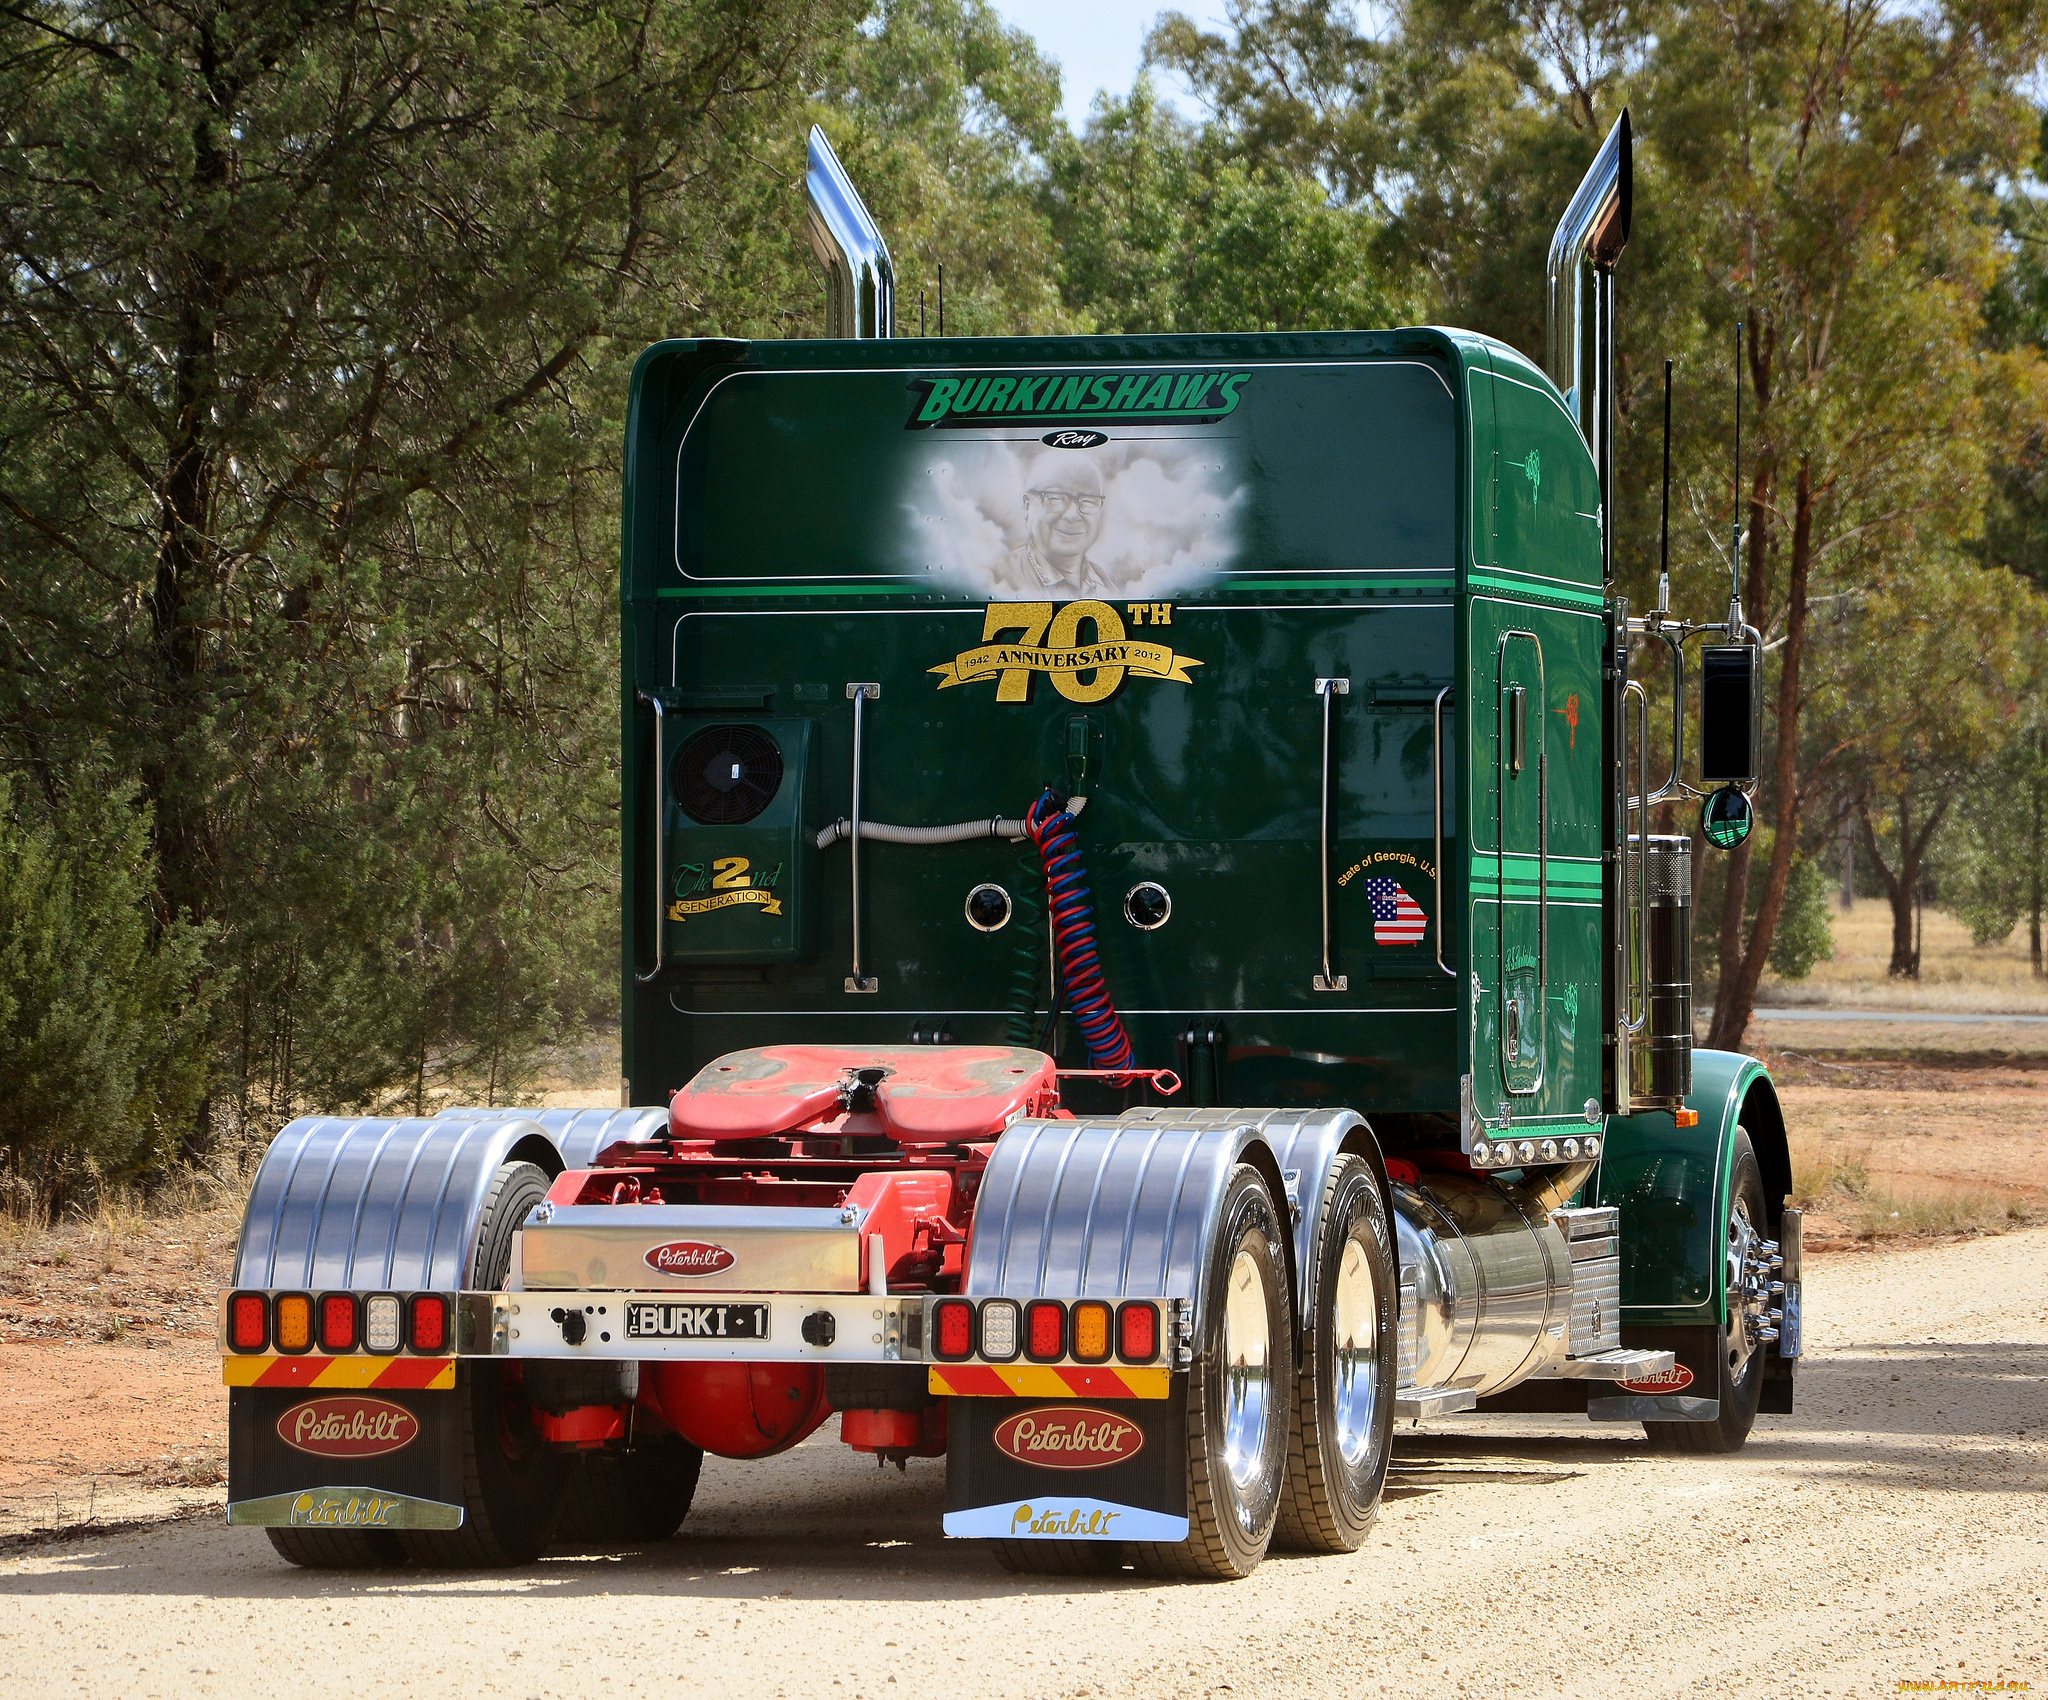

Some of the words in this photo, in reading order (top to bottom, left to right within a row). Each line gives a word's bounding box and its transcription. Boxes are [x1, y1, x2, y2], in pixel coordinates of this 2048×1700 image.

[916, 372, 1252, 422] BURKINSHAW'S
[1053, 431, 1098, 447] Ray
[965, 654, 989, 668] 1942
[996, 646, 1131, 668] ANNIVERSARY
[1134, 648, 1161, 662] 2012
[672, 863, 711, 897] The
[1337, 863, 1361, 887] State
[1362, 854, 1372, 867] of
[1374, 852, 1417, 867] Georgia,
[678, 891, 769, 912] GENERATION
[657, 1247, 725, 1267] Peterbilt
[295, 1407, 408, 1443] Peterbilt
[1013, 1417, 1132, 1453] Peterbilt
[290, 1492, 399, 1526] Peterbilt
[1011, 1503, 1121, 1535] Peterbilt
